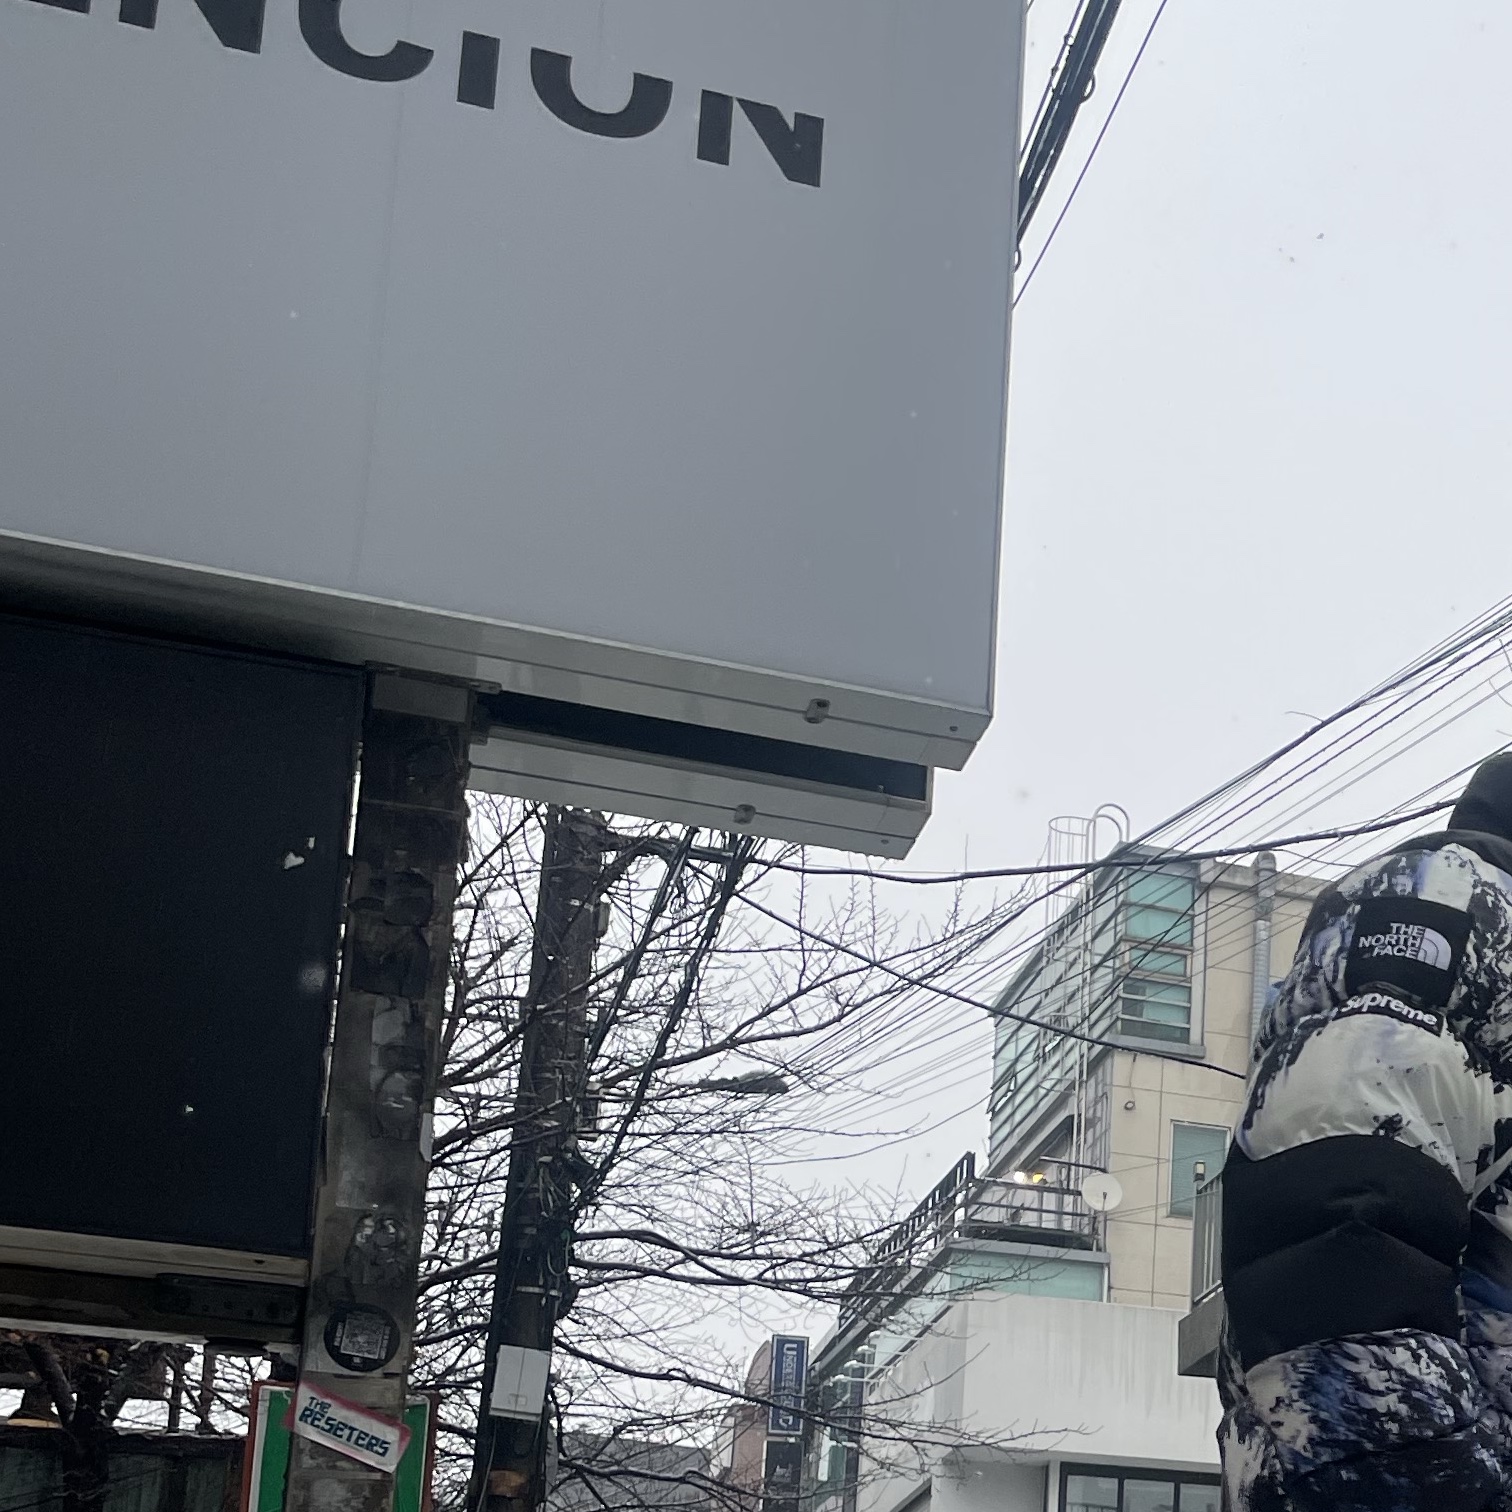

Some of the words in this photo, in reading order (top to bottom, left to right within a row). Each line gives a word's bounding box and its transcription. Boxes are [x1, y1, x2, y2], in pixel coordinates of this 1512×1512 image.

[1390, 922, 1426, 936] THE
[1358, 934, 1421, 948] NORTH
[1372, 945, 1418, 960] FACE
[309, 1396, 332, 1414] THE
[299, 1406, 391, 1458] RESETERS
